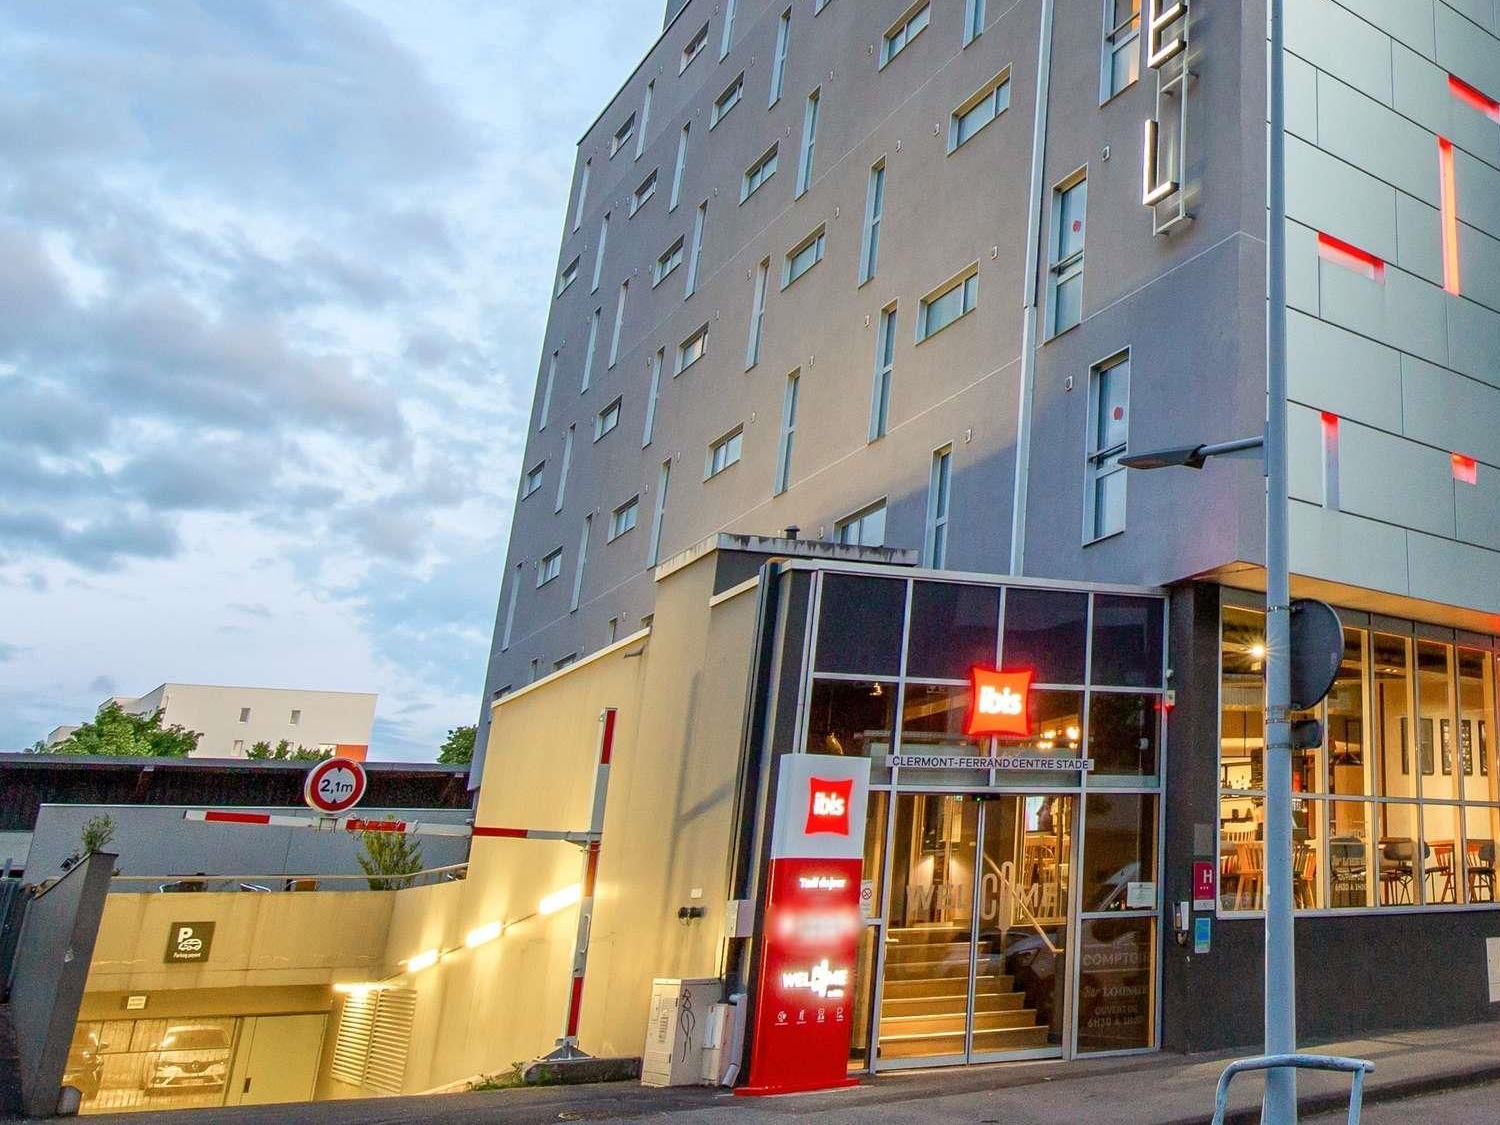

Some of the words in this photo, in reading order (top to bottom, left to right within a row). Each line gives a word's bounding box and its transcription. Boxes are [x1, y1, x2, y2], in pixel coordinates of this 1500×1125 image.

[978, 686, 1023, 715] ibis
[892, 756, 1011, 769] CLERMONT-FERRAND
[1011, 758, 1054, 769] CENTRE
[1056, 759, 1089, 770] STADE
[320, 779, 353, 794] 2,1m
[813, 791, 845, 817] ibis
[1203, 869, 1213, 884] H
